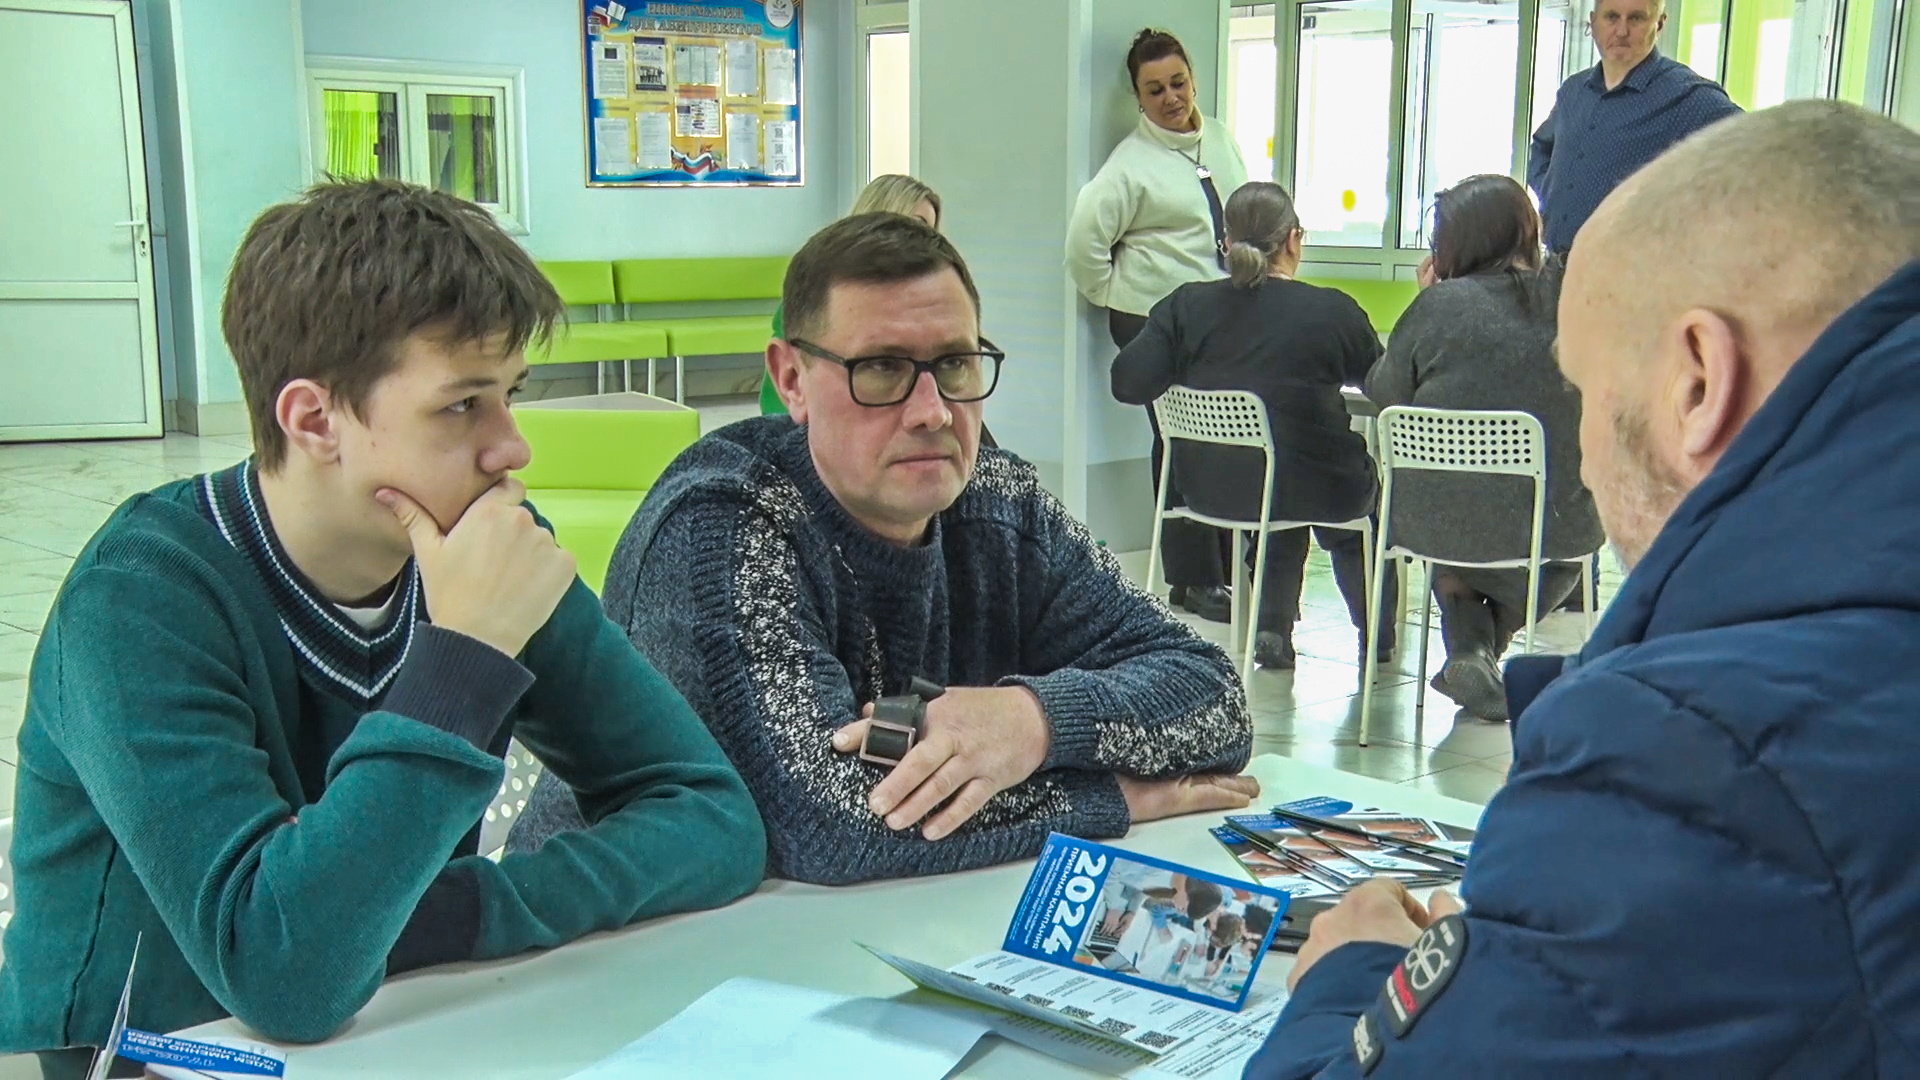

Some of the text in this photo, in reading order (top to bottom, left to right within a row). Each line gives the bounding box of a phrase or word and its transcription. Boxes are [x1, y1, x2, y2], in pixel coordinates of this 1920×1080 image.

[1053, 847, 1079, 897] ПРИЕМНАЯ
[1042, 850, 1107, 955] 2024
[1032, 897, 1058, 950] КАМПАНИЯ
[127, 1036, 166, 1049] ТЕБЯ
[168, 1044, 230, 1060] ИМЕННО
[234, 1055, 275, 1072] ЖДЕМ
